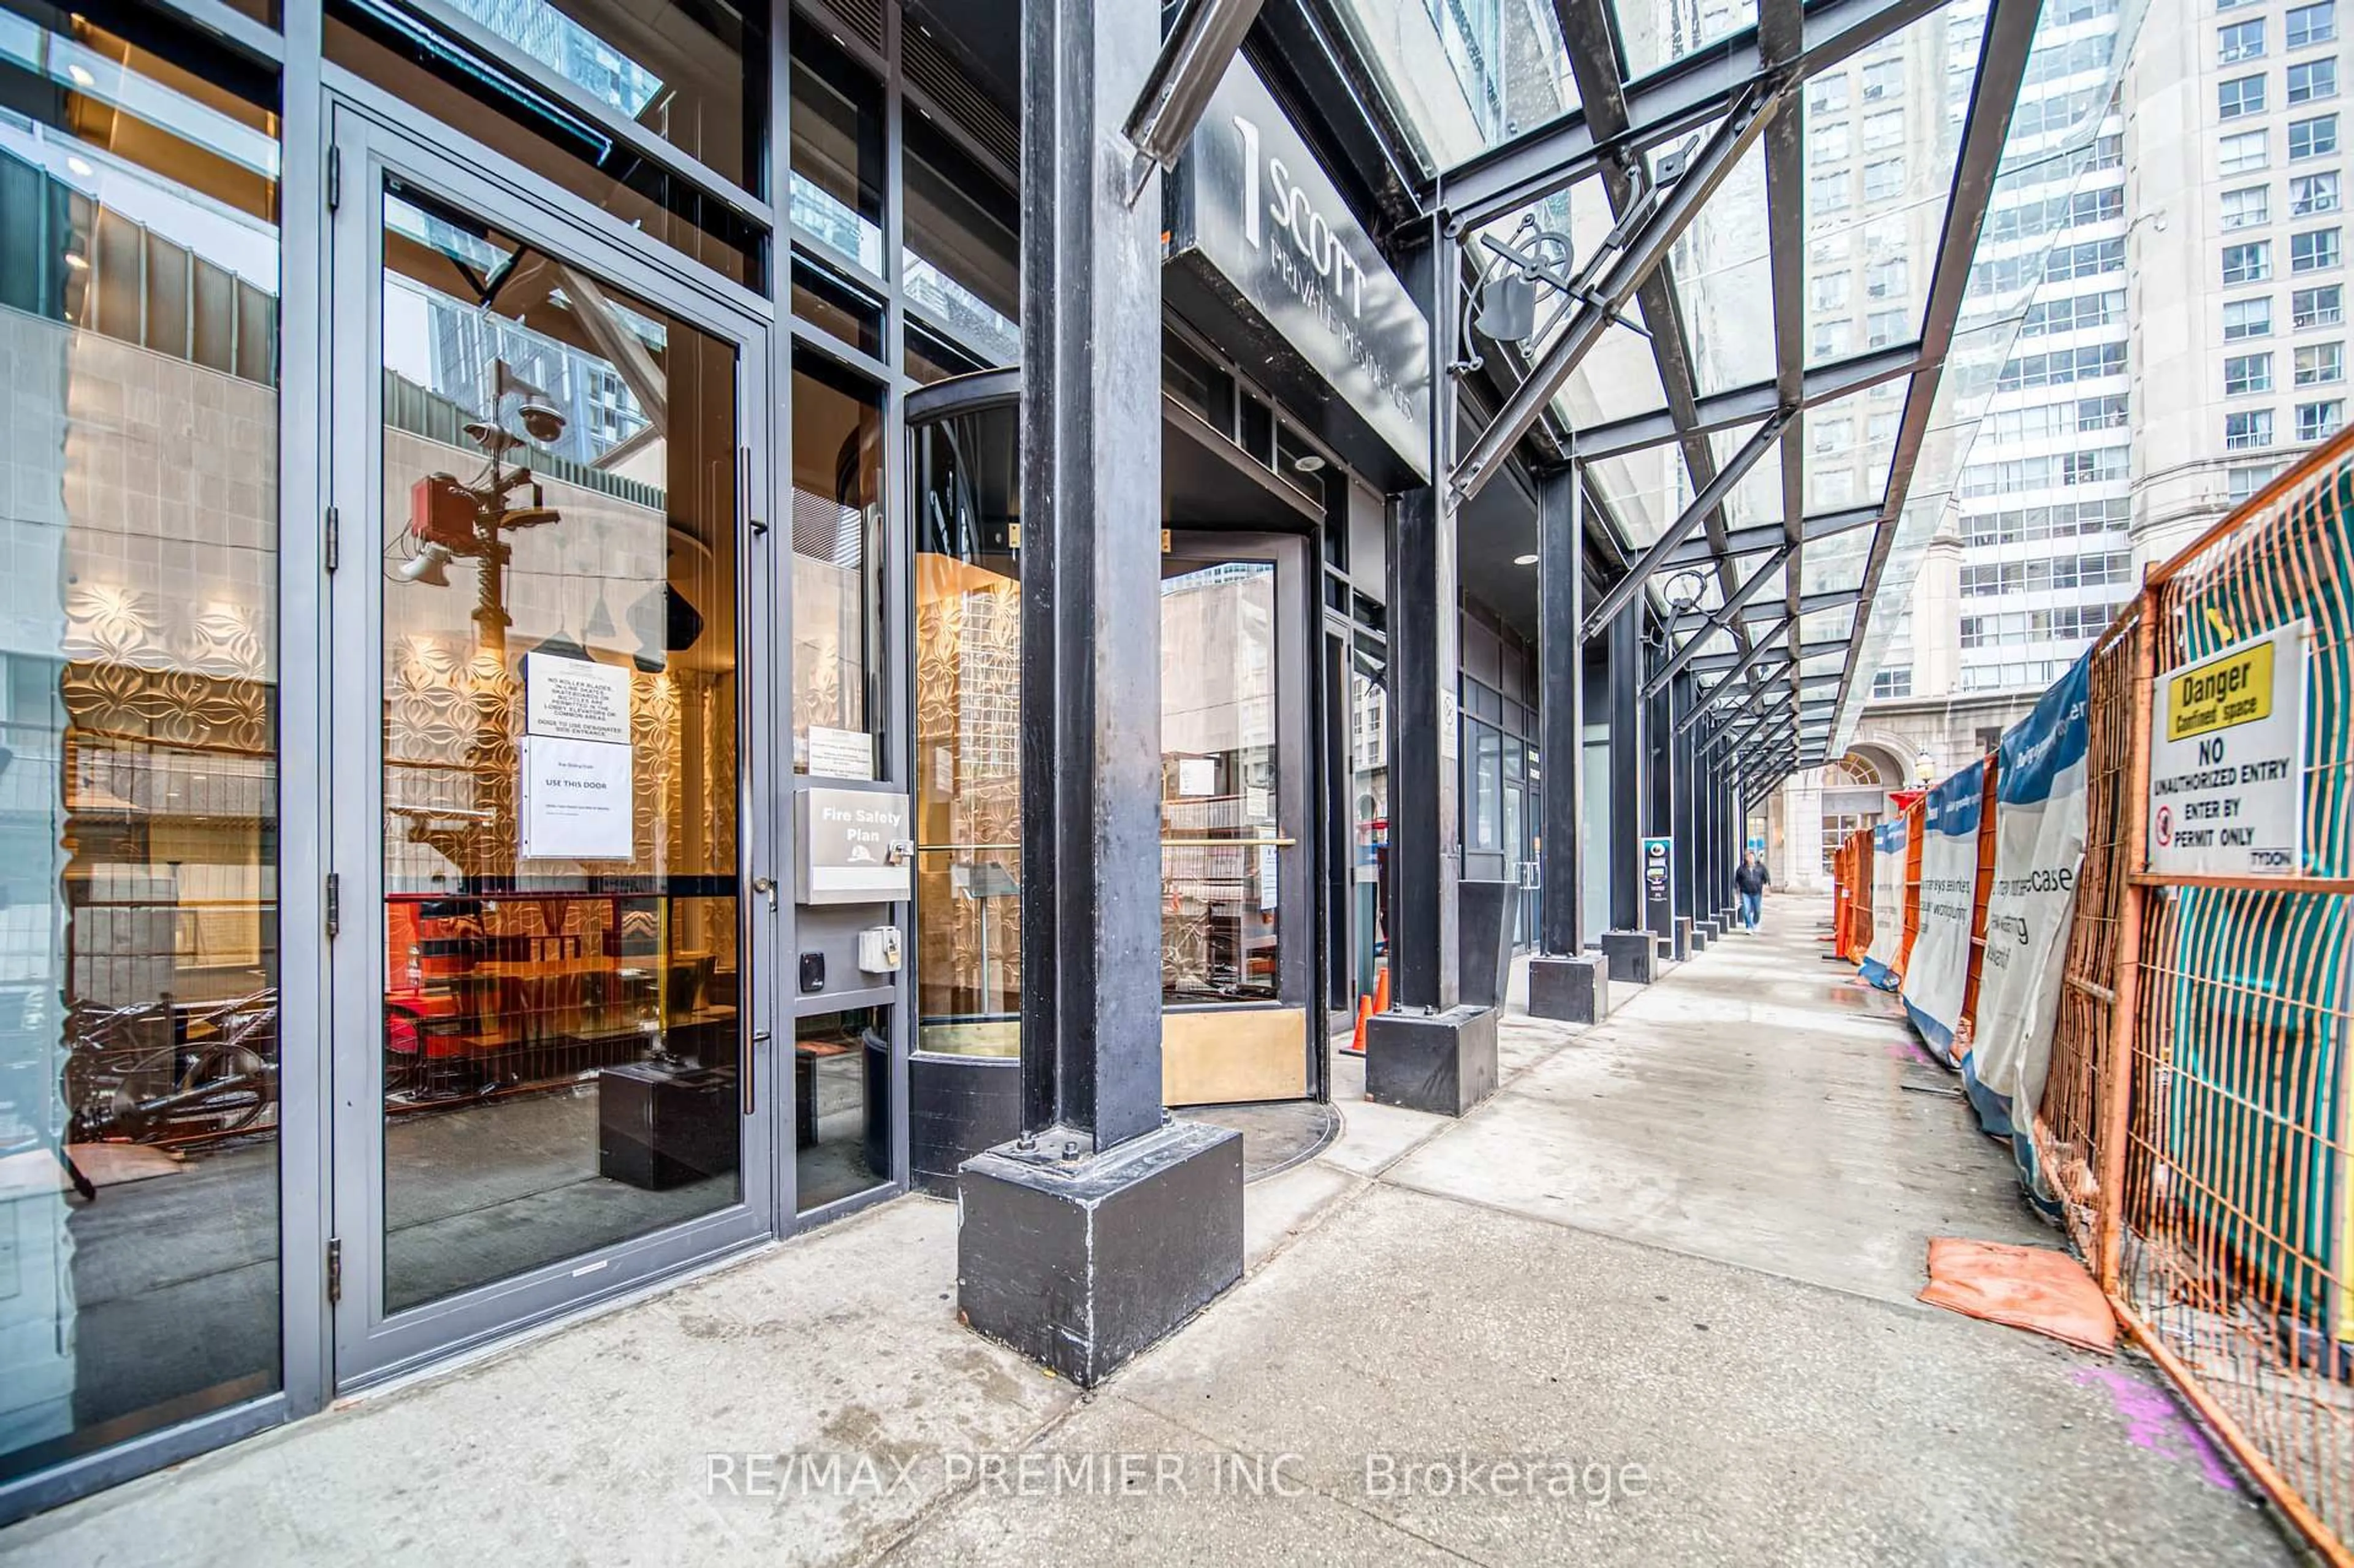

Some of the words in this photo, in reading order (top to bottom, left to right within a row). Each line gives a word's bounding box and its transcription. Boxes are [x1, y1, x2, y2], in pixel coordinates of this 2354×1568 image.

[1233, 115, 1260, 249] 1
[1270, 158, 1366, 318] SCOTT
[1270, 236, 1337, 334] PRIVATE
[2182, 661, 2252, 708] Danger
[2176, 707, 2217, 733] Confined
[2223, 697, 2257, 723] space
[2198, 737, 2225, 767] NO
[2154, 767, 2236, 796] UNAUTHORIZED
[2241, 757, 2290, 783] ENTRY
[823, 806, 851, 821] Fire
[2185, 799, 2220, 820] ENTER
[2224, 797, 2241, 816] BY
[847, 828, 880, 842] Plan
[2174, 829, 2215, 848] PERMIT
[2220, 827, 2255, 847] ONLY
